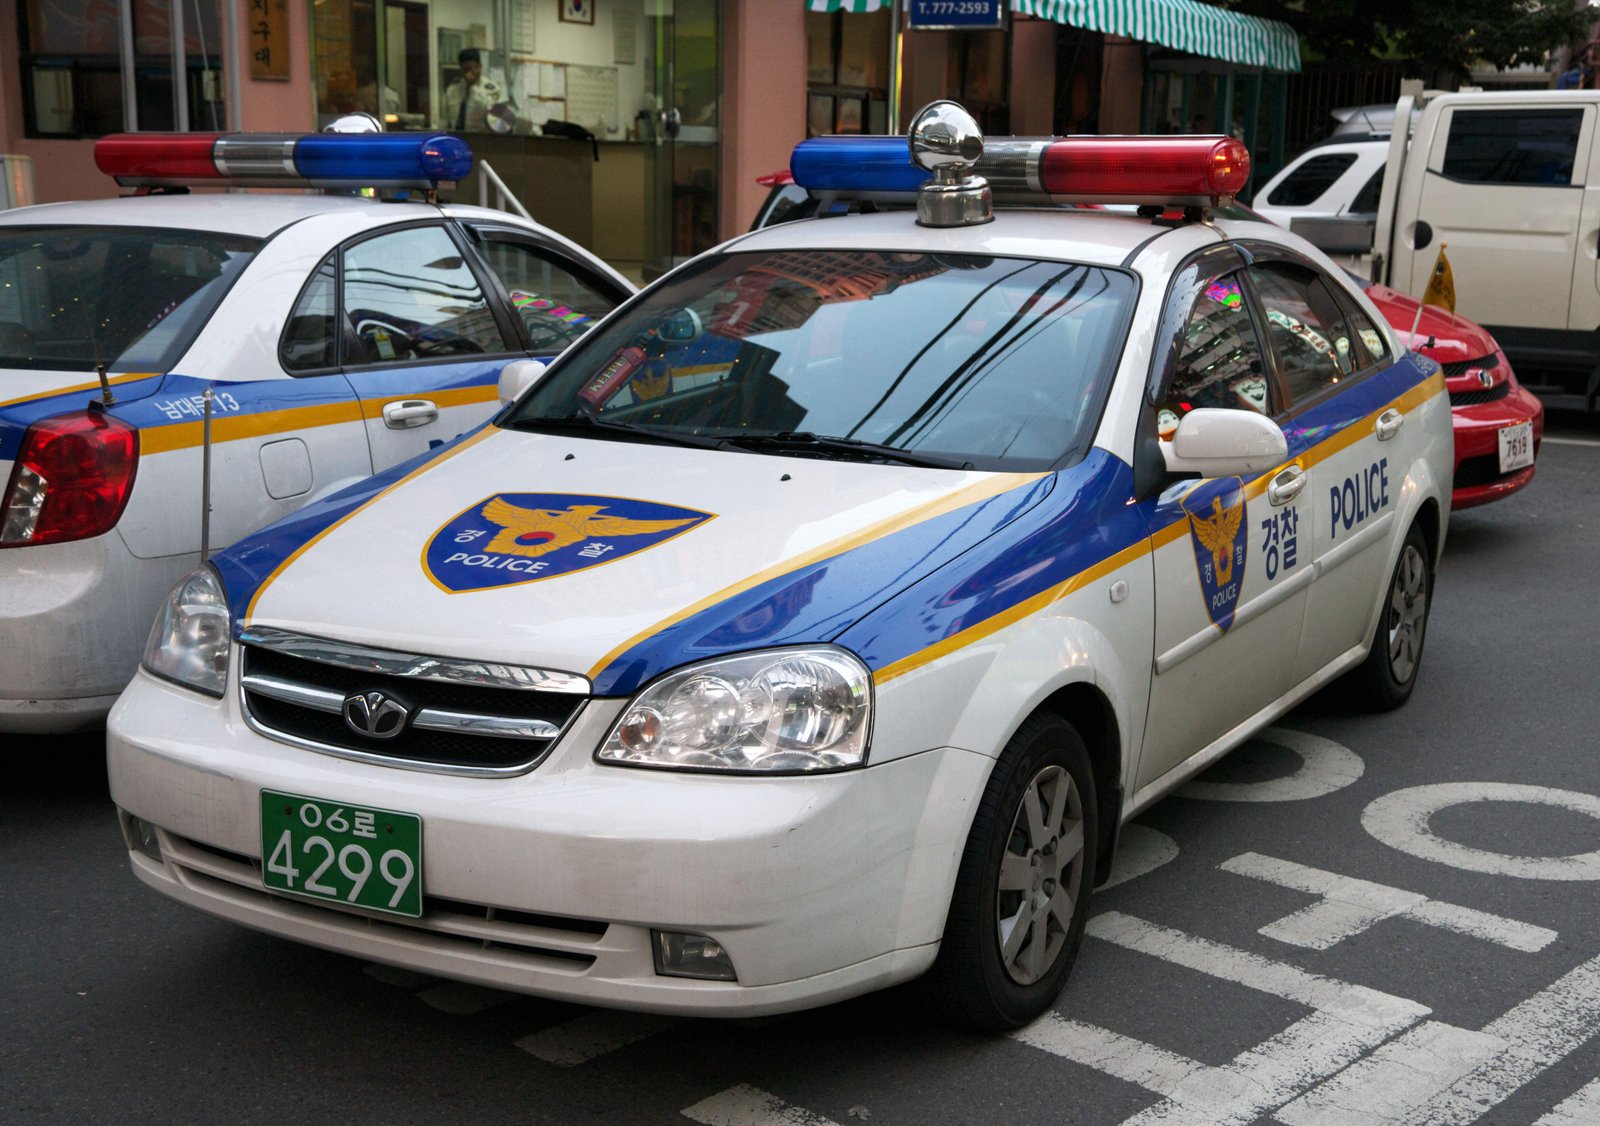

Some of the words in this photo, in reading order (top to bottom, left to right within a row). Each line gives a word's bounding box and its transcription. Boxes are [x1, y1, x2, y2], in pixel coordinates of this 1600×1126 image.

[932, 2, 989, 14] 777-2593
[1330, 457, 1388, 539] POLICE
[1261, 505, 1299, 581] 경찰
[443, 552, 549, 575] POLICE
[1212, 583, 1237, 610] POLICE
[300, 803, 377, 839] 06로
[267, 829, 415, 908] 4299
